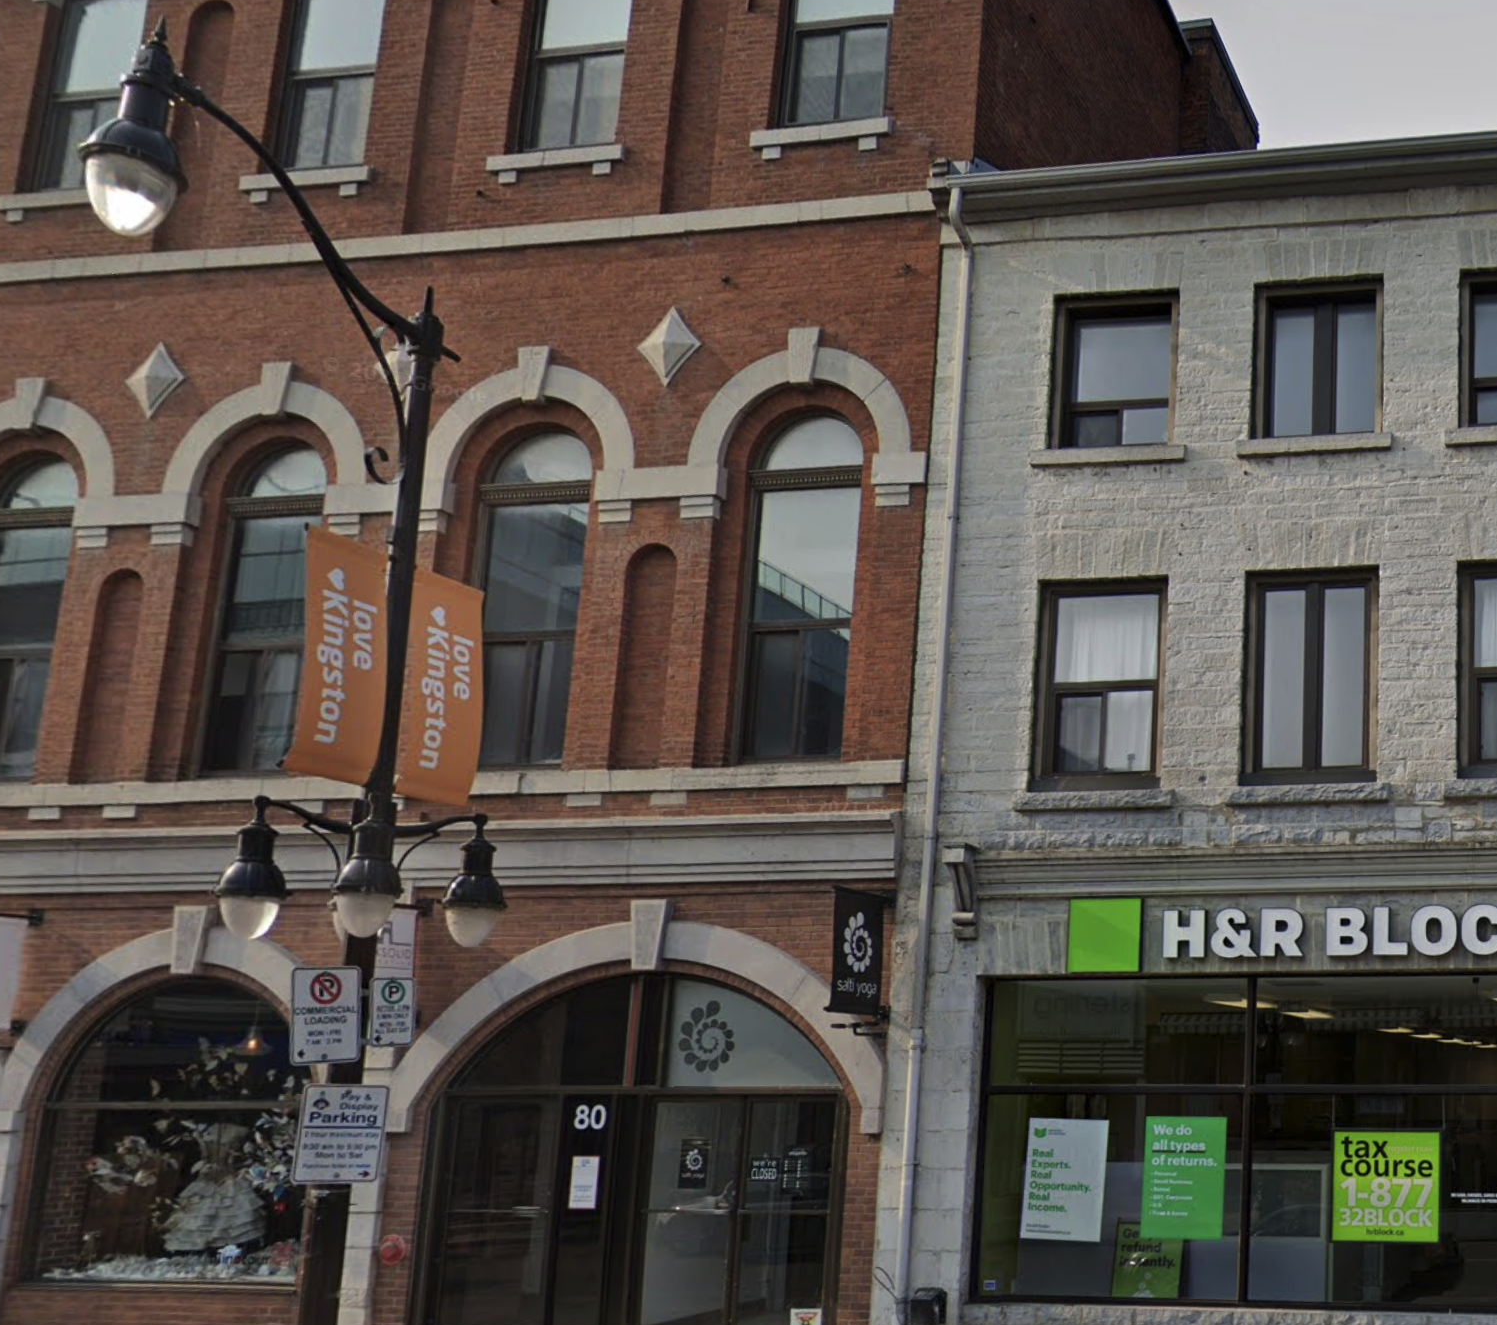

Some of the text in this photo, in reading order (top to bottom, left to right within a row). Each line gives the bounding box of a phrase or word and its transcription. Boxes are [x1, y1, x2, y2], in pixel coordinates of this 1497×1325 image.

[353, 599, 378, 671] love
[452, 634, 475, 701] love
[1162, 906, 1304, 960] H&R
[856, 981, 877, 998] yoga
[295, 1005, 357, 1015] COMMERCIAL
[304, 1016, 348, 1025] LOADING
[339, 1103, 379, 1112] Display
[309, 1111, 378, 1127] Parking
[573, 1104, 607, 1131] 80
[1153, 1124, 1193, 1136] We do
[1152, 1139, 1206, 1153] all types
[1341, 1135, 1389, 1159] tax
[1032, 1148, 1054, 1158] Real
[1031, 1159, 1071, 1170] Experts.
[1152, 1154, 1218, 1167] of returns.
[750, 1168, 778, 1180] CLOSED
[1030, 1170, 1053, 1179] Real
[1340, 1159, 1434, 1178] course
[1029, 1181, 1092, 1194] Opportunity.
[1340, 1177, 1434, 1208] 1-877
[1029, 1192, 1050, 1201] Real
[1027, 1202, 1067, 1213] Income.
[1339, 1208, 1433, 1227] 32BLOCK
[1365, 1228, 1405, 1237] hrblock.ca
[1121, 1241, 1162, 1253] refund
